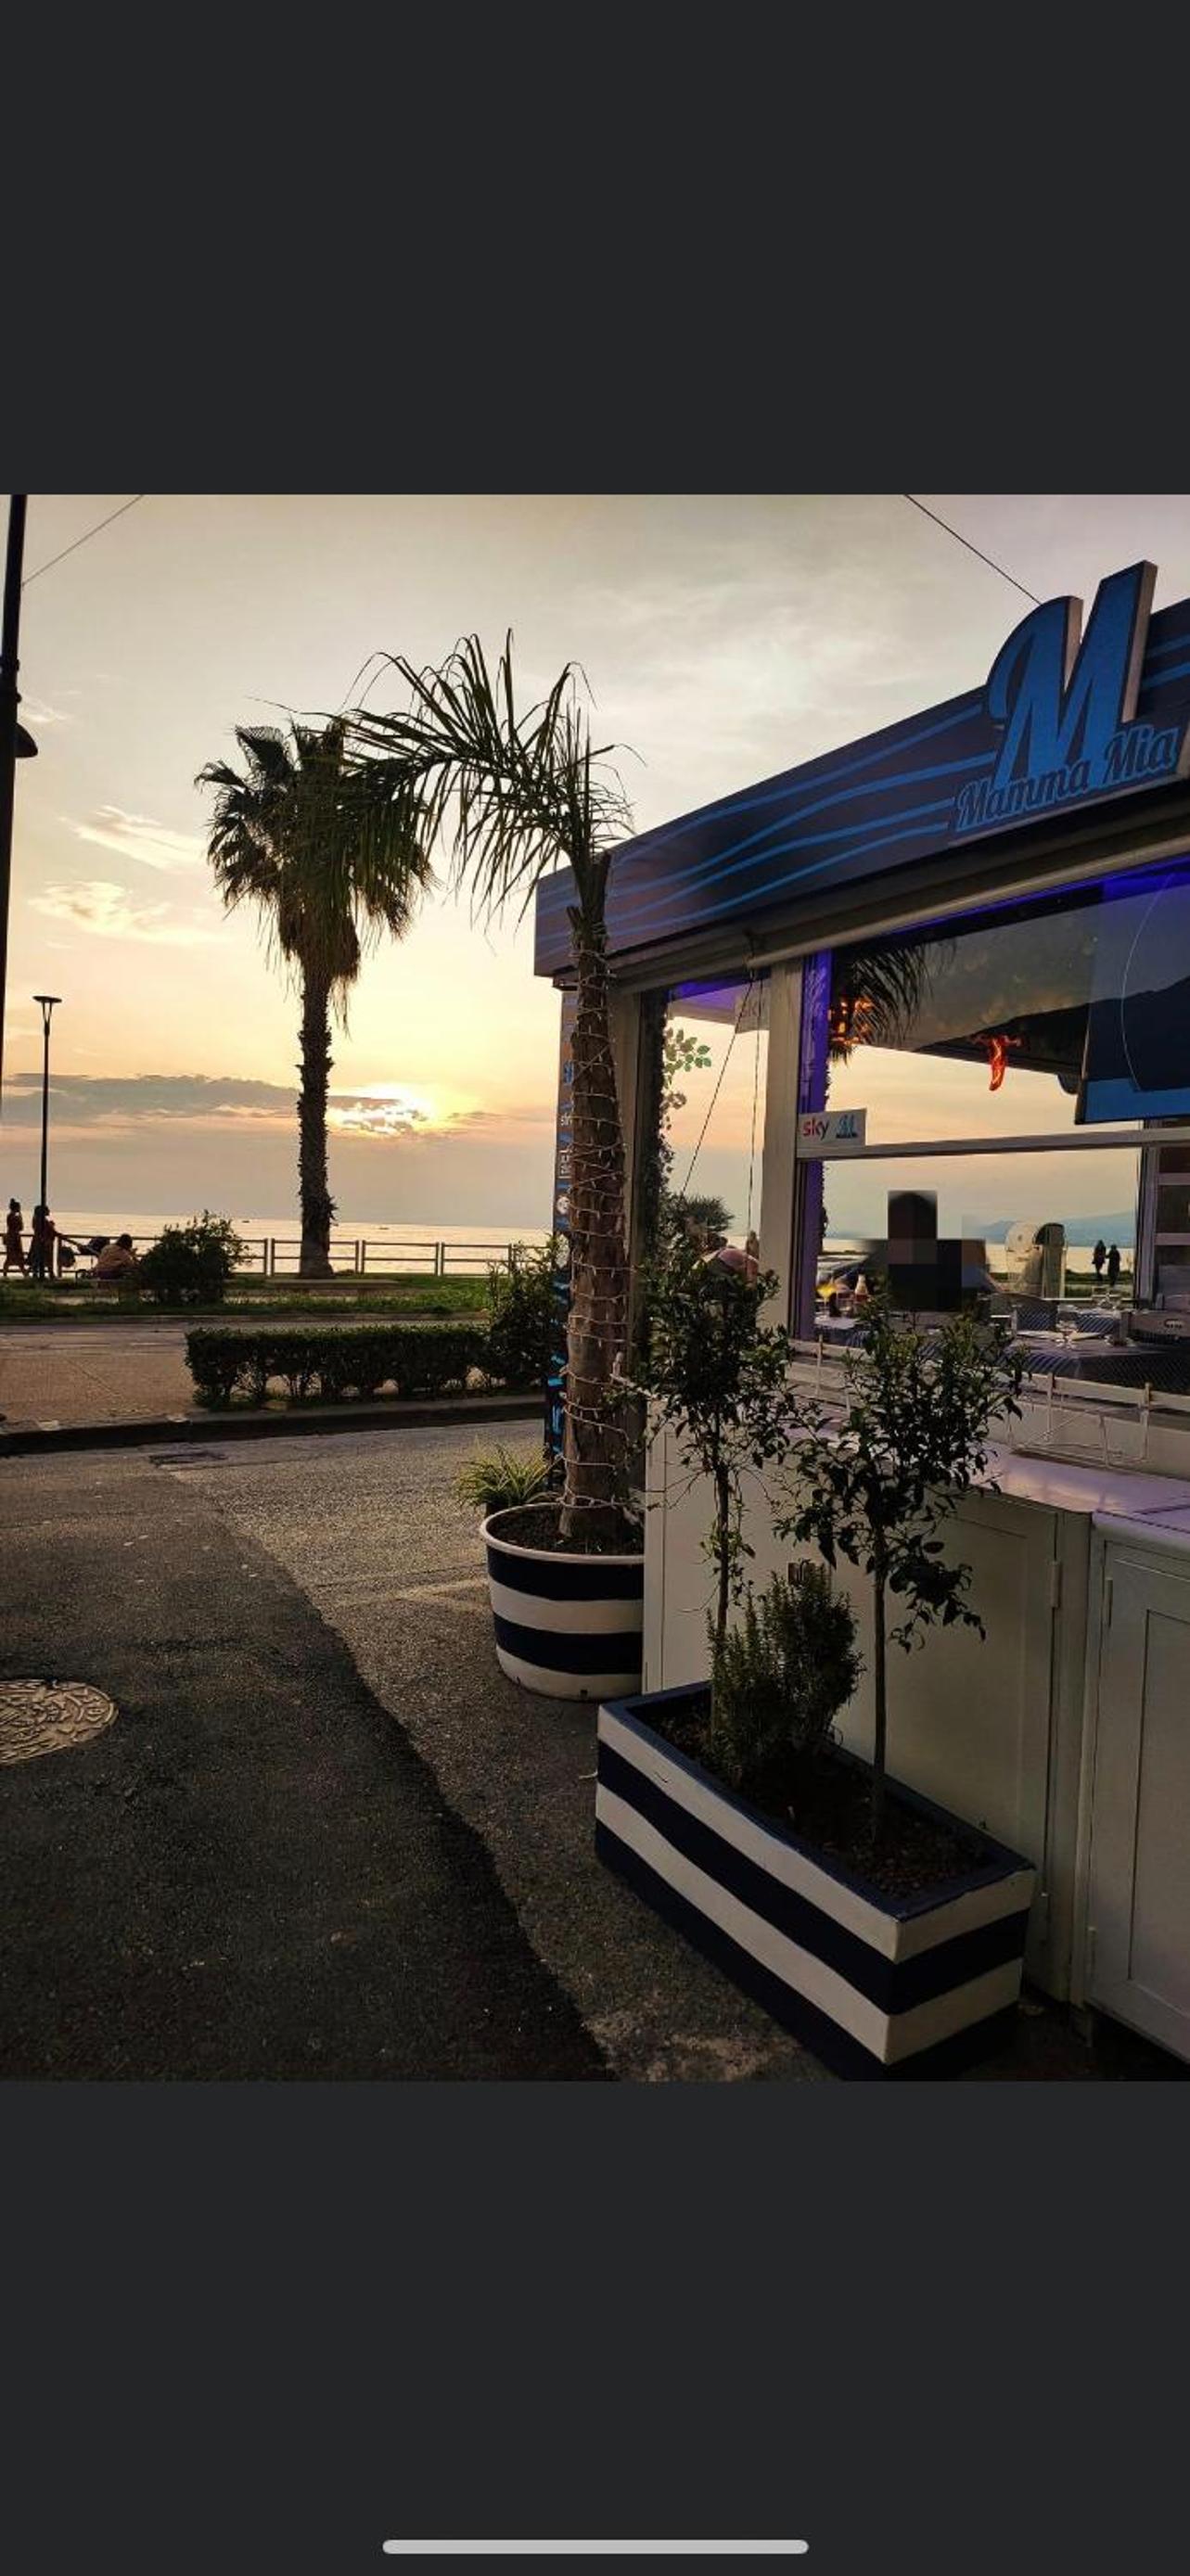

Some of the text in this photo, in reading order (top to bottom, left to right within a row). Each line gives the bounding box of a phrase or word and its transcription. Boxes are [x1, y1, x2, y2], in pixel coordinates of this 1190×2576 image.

[985, 560, 1158, 788] M
[956, 722, 1180, 831] Mamma Mia
[802, 1116, 829, 1141] sky
